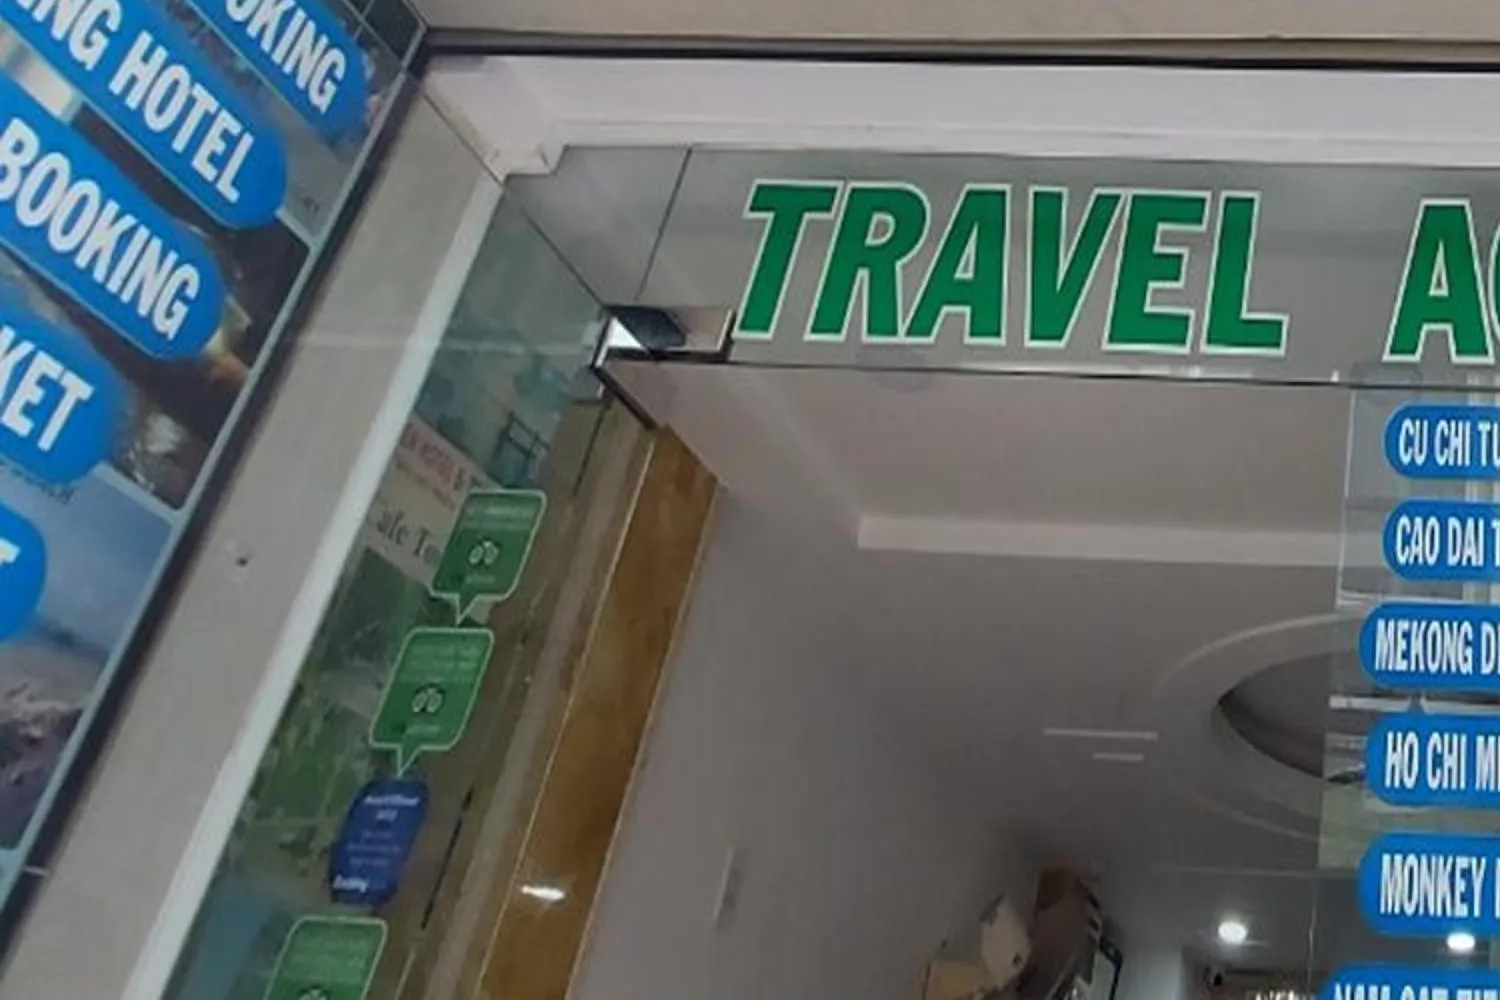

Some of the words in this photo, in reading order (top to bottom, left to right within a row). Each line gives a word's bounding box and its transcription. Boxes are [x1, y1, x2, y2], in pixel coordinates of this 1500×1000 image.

[108, 30, 254, 204] HOTEL
[731, 178, 1290, 357] TRAVEL
[1399, 418, 1428, 465] CU
[1434, 419, 1471, 468] CHI
[1395, 515, 1440, 567] CAO
[1447, 517, 1484, 567] DAI
[1375, 618, 1473, 674] MEKONG
[1384, 730, 1418, 789] HO
[1426, 731, 1467, 789] CHI
[1380, 853, 1486, 918] MONKEY
